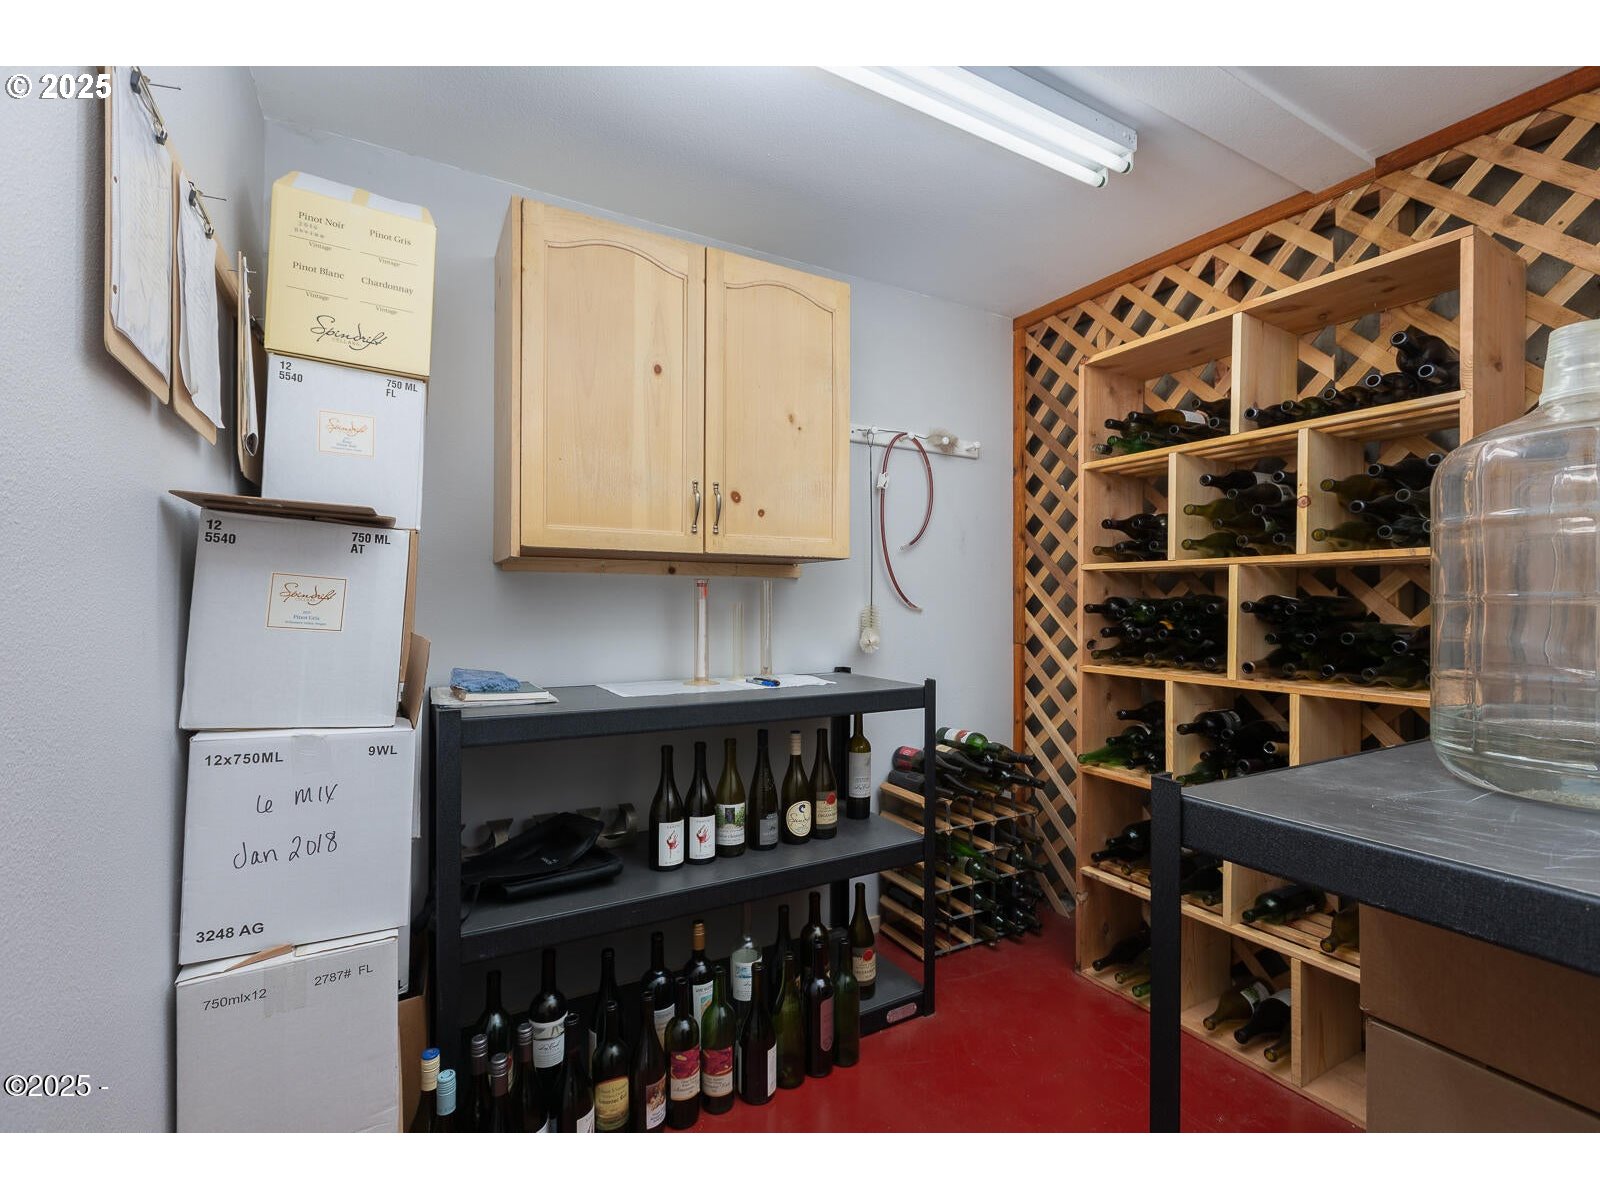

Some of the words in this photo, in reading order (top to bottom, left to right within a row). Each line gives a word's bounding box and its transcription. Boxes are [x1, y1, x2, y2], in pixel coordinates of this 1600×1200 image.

[298, 211, 322, 224] Pinot
[325, 217, 344, 229] Noir
[369, 229, 392, 241] Pinot
[394, 235, 412, 246] Gris
[308, 240, 332, 251] Vintage
[378, 256, 401, 267] Vintage
[292, 261, 317, 273] Pinot
[319, 267, 345, 280] Blanc
[361, 276, 414, 296] Chardonnay
[305, 290, 330, 301] Vintage
[375, 304, 398, 315] Vintage
[310, 315, 387, 351] Spindrift
[280, 361, 292, 371] 12
[278, 371, 303, 383] 5540
[386, 379, 402, 390] 750
[404, 382, 418, 393] ML
[386, 389, 397, 398] FL
[206, 519, 222, 531] 12
[204, 532, 236, 545] 5540
[352, 532, 372, 544] 750
[374, 534, 391, 545] ML
[350, 544, 365, 554] AT
[368, 745, 398, 756] 9WL
[204, 752, 284, 766] 12x750ML
[233, 842, 278, 870] Jan
[288, 830, 338, 862] 2018
[196, 927, 235, 943] 3248
[239, 922, 265, 937] AG
[314, 968, 352, 986] 2787#
[358, 964, 374, 976] FL
[203, 988, 267, 1011] 750mlx12
